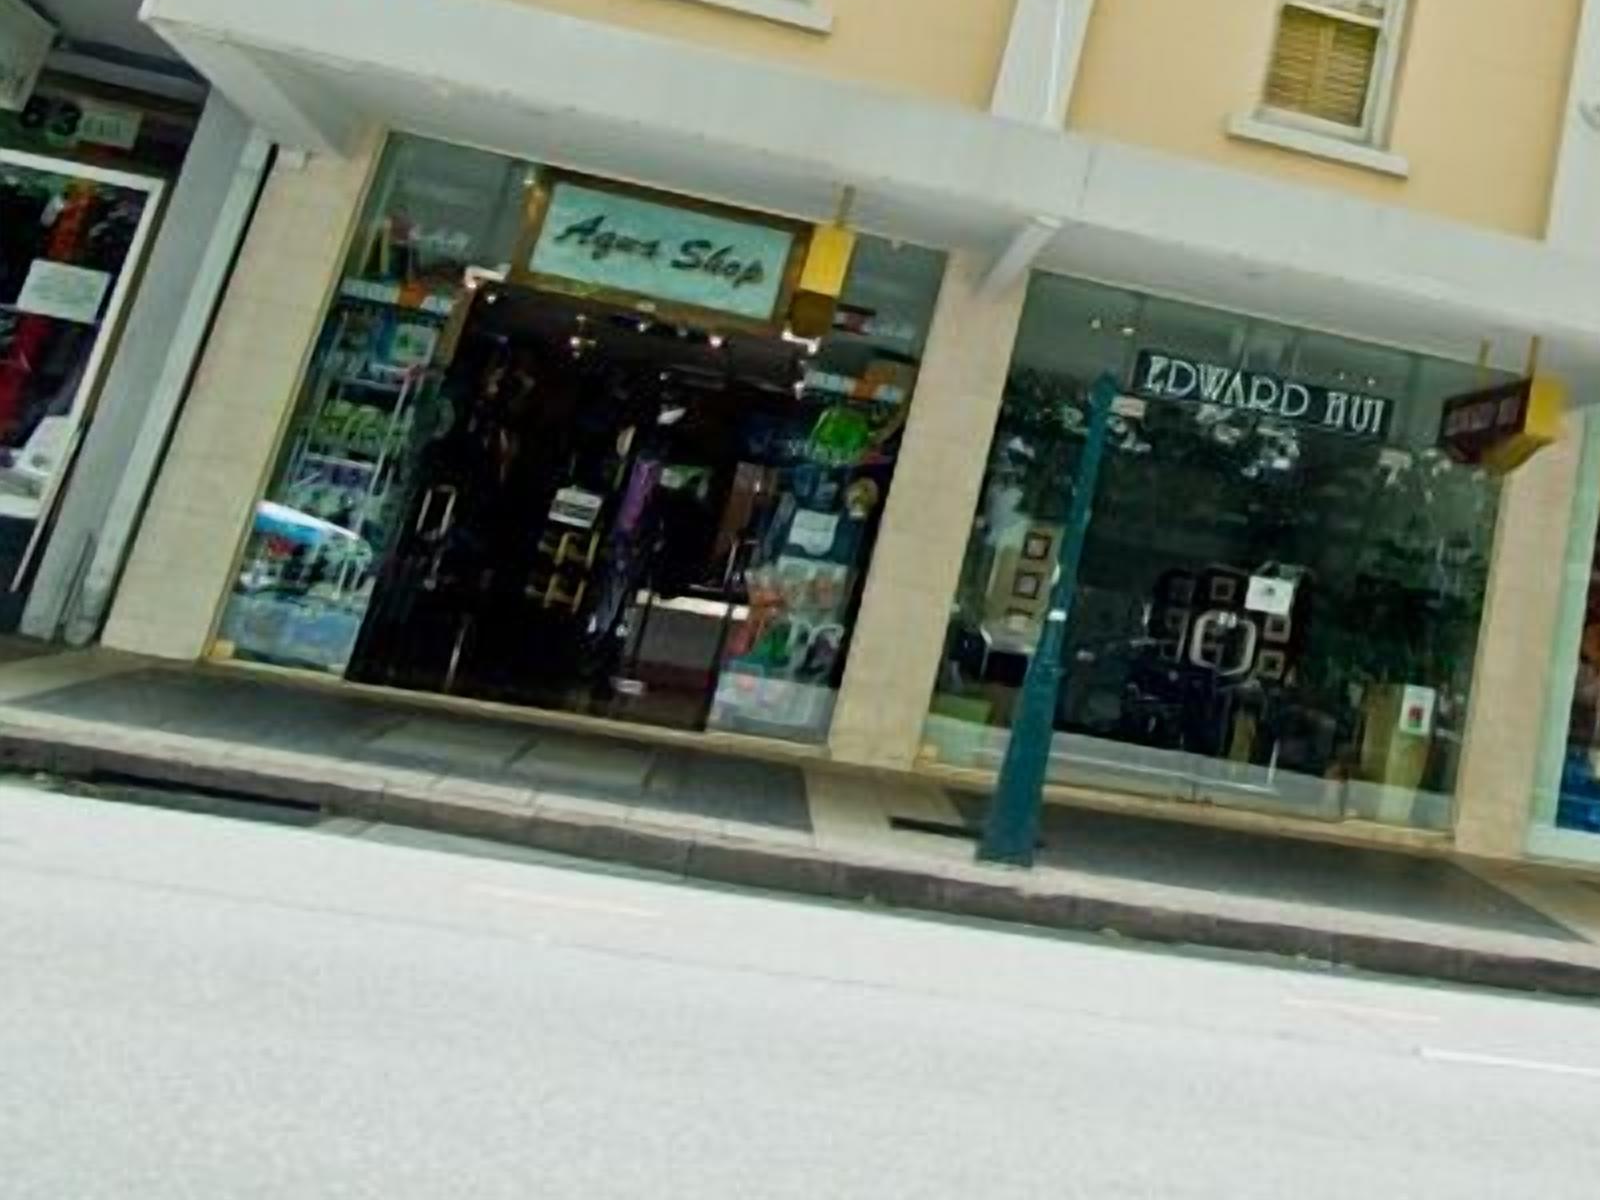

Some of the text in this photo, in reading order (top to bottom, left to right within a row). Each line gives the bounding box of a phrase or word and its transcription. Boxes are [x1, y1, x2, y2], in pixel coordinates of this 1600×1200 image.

[554, 213, 766, 289] Aqua Shop
[1145, 355, 1311, 417] EDWARD
[1322, 390, 1386, 435] HUI
